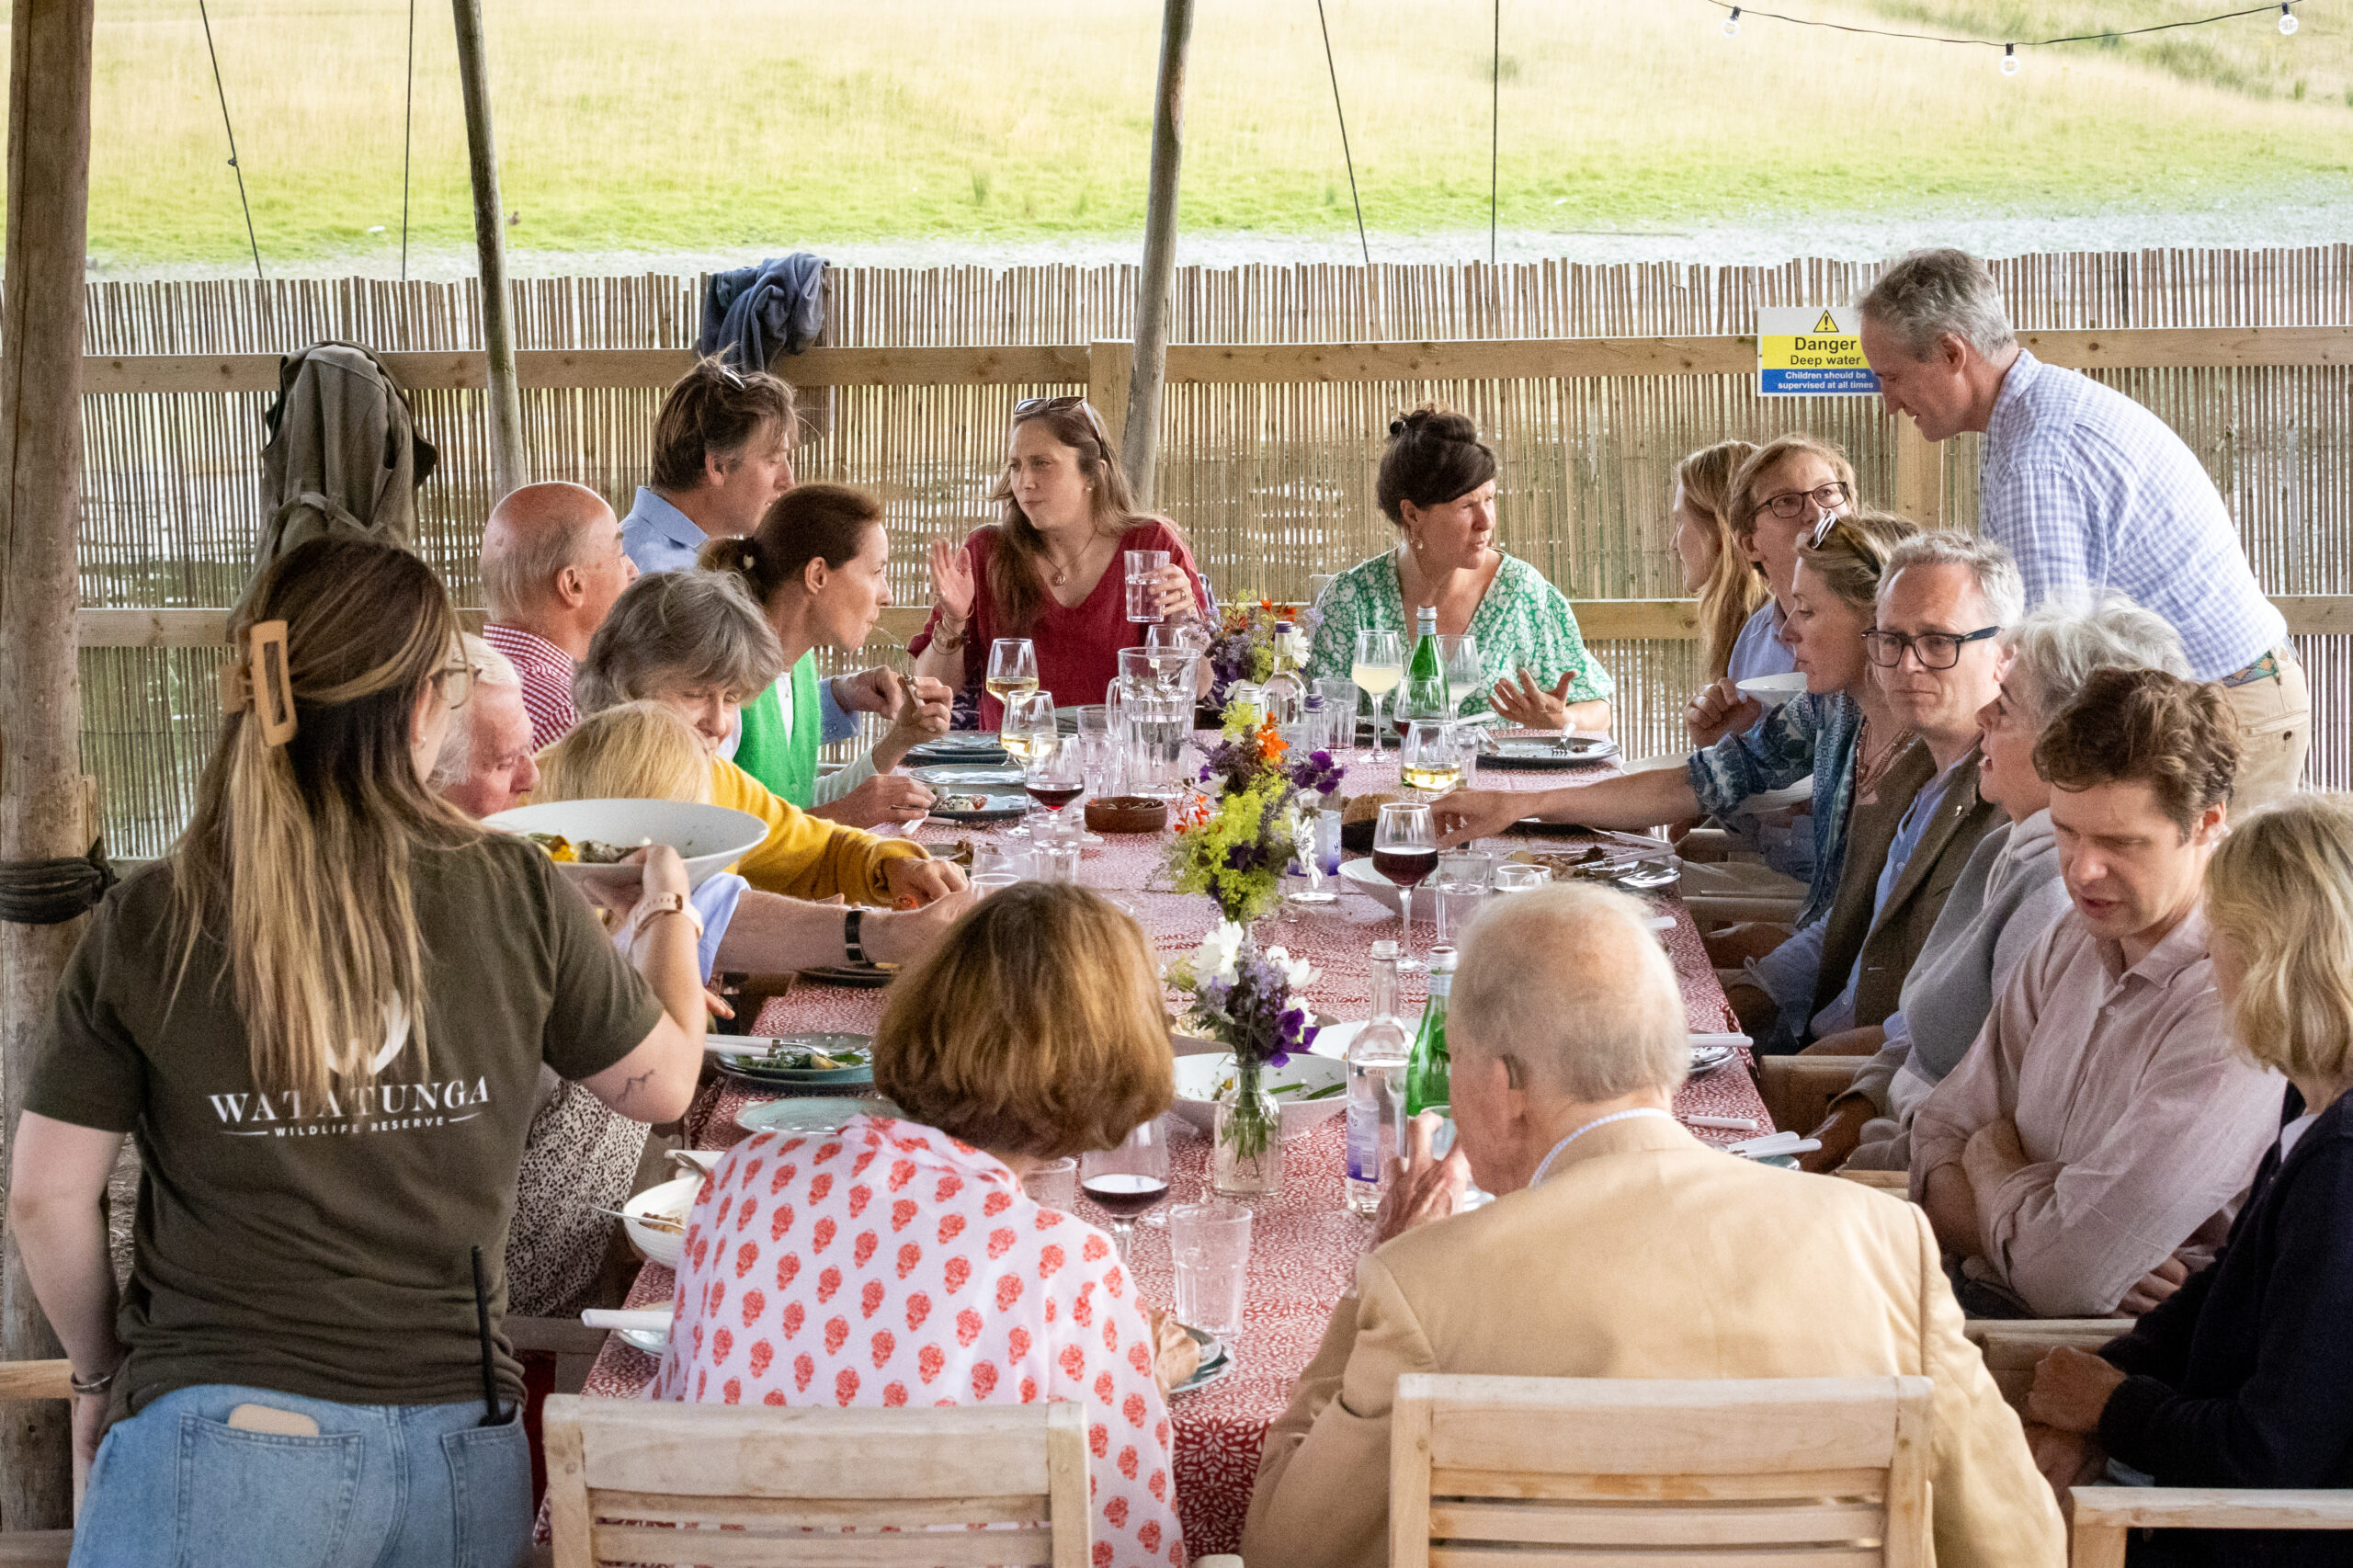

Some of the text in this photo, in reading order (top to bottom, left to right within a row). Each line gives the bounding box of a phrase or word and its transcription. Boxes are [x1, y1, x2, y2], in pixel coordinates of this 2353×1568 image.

[1795, 337, 1857, 354] Danger
[1790, 355, 1861, 367] Deep water
[1785, 371, 1867, 380] Children should be
[1778, 381, 1825, 391] supervised
[207, 1074, 491, 1123] WATATUNGA
[275, 1116, 444, 1137] WILDLIFE RESERVE
